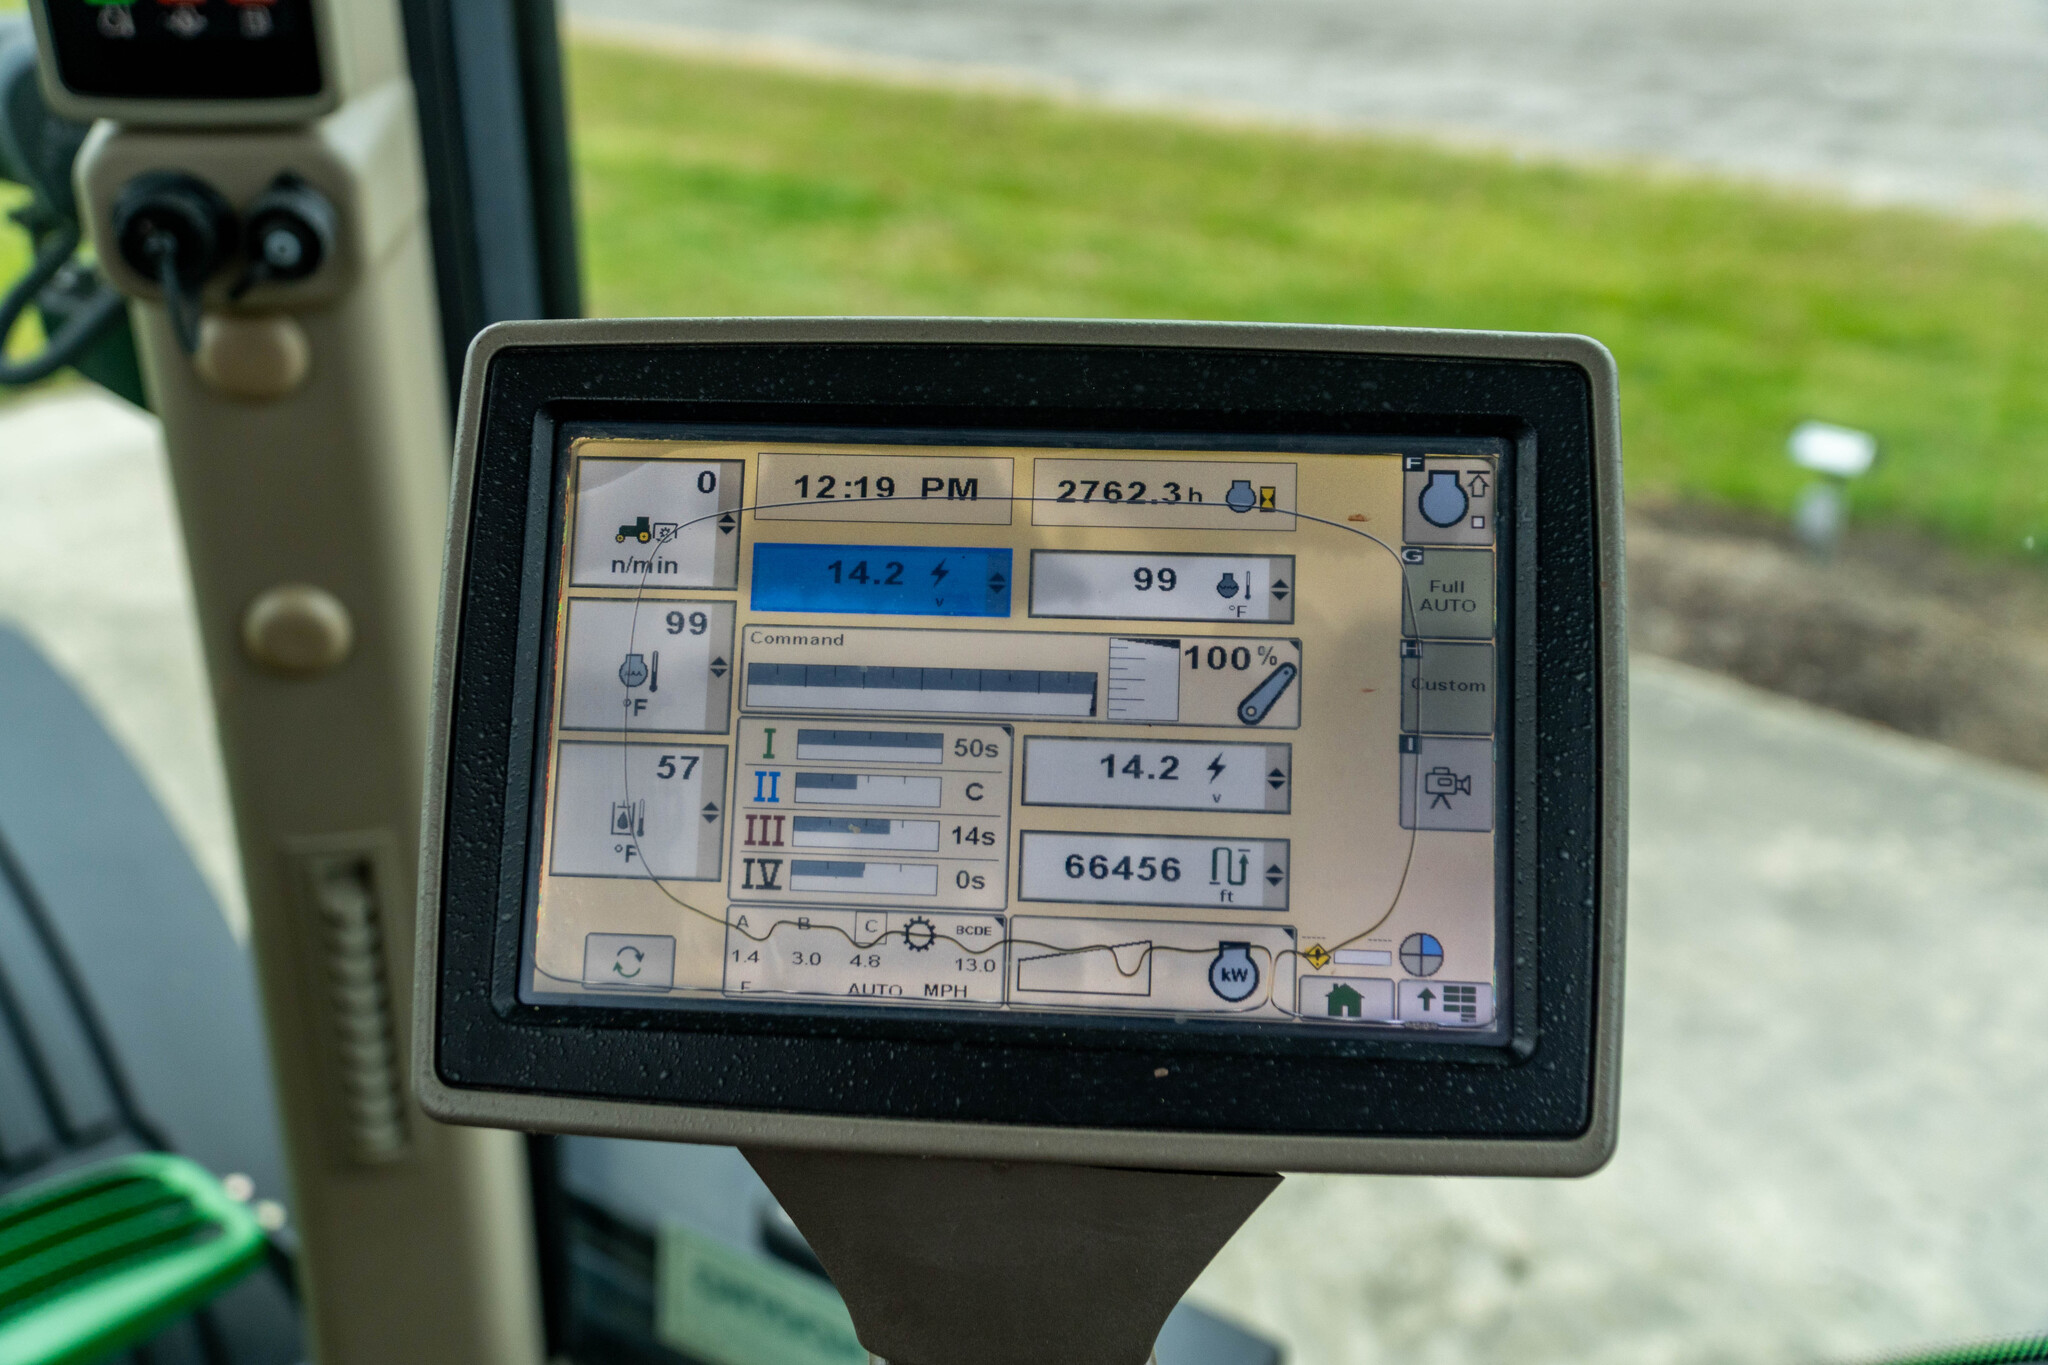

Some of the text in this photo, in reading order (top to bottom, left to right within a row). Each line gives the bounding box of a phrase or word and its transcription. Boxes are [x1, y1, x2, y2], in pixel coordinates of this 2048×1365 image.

[1406, 457, 1422, 469] F
[697, 470, 716, 494] 0
[794, 474, 978, 501] 12:19 PM
[1401, 549, 1423, 563] G
[611, 556, 678, 574] n/min
[828, 560, 904, 585] 14.2
[1133, 567, 1177, 591] 99
[1430, 580, 1465, 593] Full
[1419, 598, 1476, 613] AUTO
[666, 611, 707, 635] 99
[750, 631, 844, 646] Command
[1411, 677, 1486, 692] Custom
[763, 728, 777, 759] I
[954, 738, 999, 758] 50s
[656, 755, 700, 780] 57
[1100, 754, 1179, 780] 14.2
[754, 771, 781, 803] II
[965, 782, 984, 801] C
[744, 814, 786, 846] III
[952, 826, 996, 846] 14s
[741, 858, 783, 890] IV
[1065, 854, 1181, 882] 66456
[956, 870, 986, 890] 0s
[1220, 889, 1234, 902] ft
[736, 914, 749, 928] A
[798, 917, 810, 930] B
[865, 919, 878, 933] C
[956, 925, 992, 936] BCDE
[732, 949, 760, 963] 1.4
[792, 951, 822, 966] 3.0
[849, 954, 881, 968] 4.8
[955, 958, 996, 973] 13.0
[1221, 968, 1249, 983] kW
[848, 983, 903, 996] AUTO
[924, 983, 967, 998] MPH
